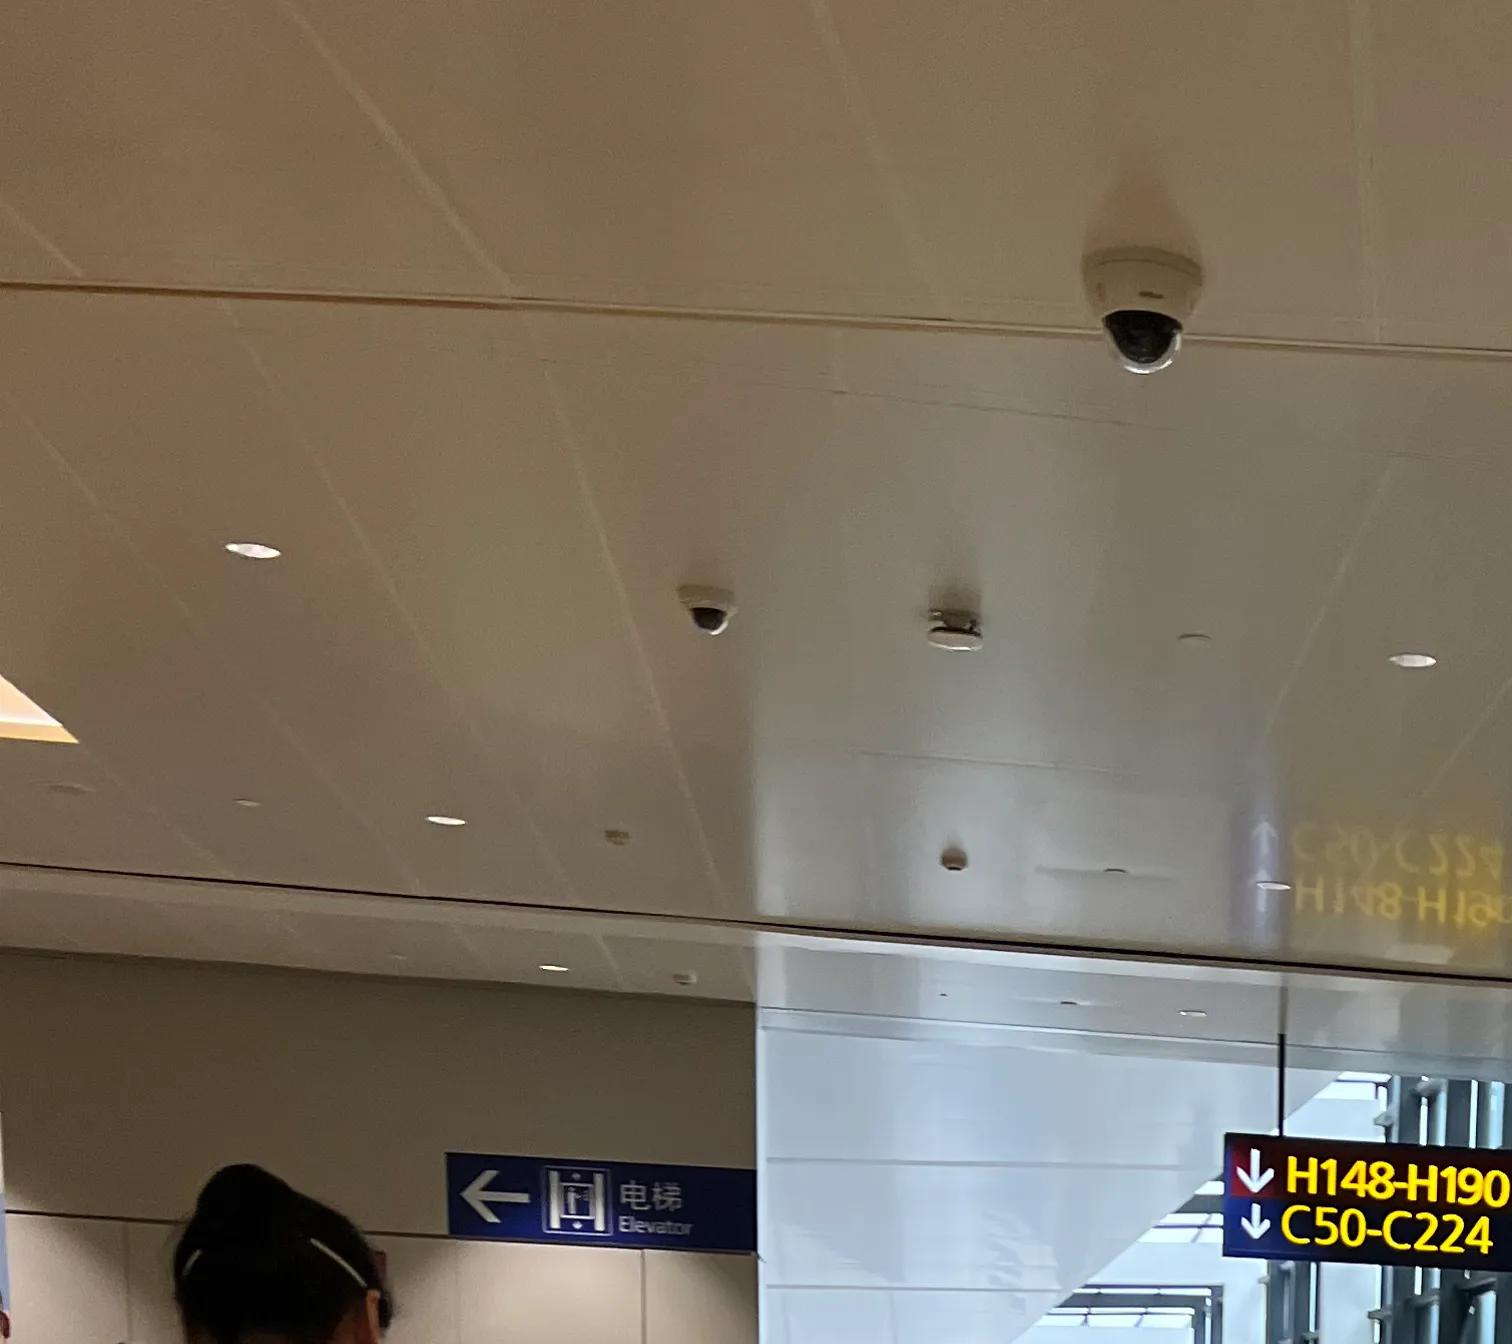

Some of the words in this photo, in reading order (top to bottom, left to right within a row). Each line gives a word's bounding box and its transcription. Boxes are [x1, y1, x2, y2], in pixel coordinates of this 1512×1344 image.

[619, 1182, 683, 1212] 电梯
[618, 1215, 693, 1237] Elevator
[1281, 1204, 1494, 1255] C50-C224
